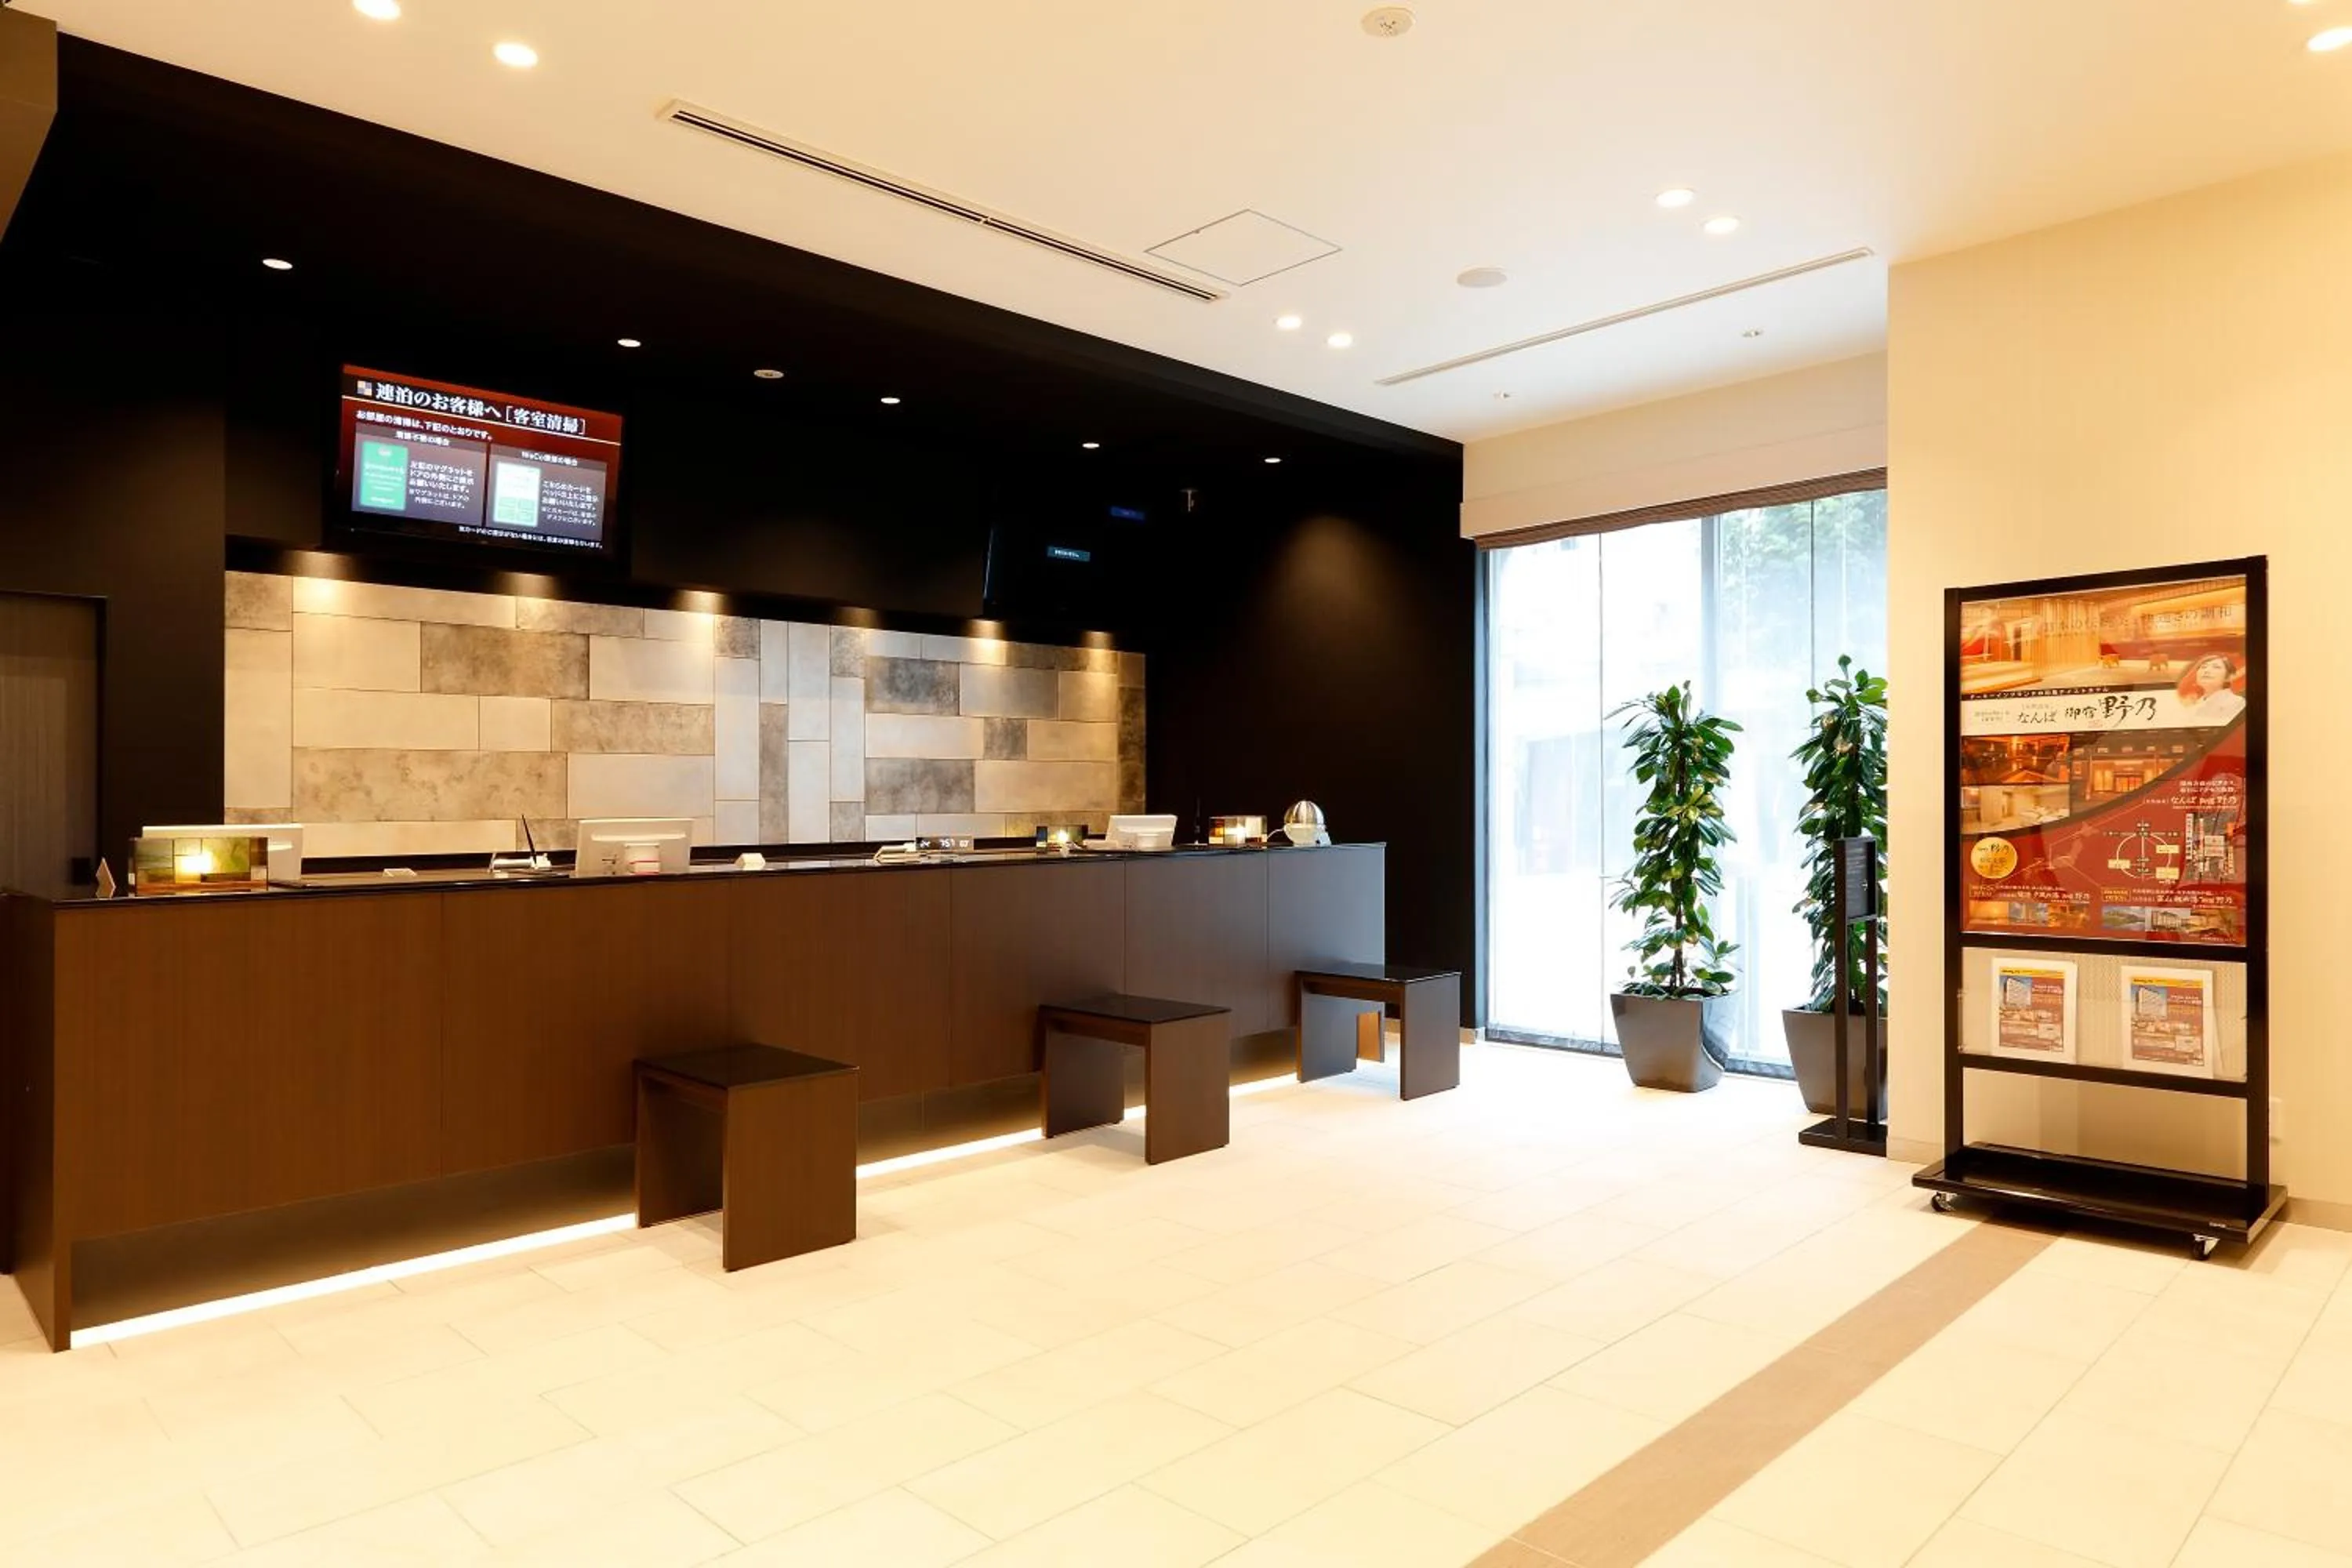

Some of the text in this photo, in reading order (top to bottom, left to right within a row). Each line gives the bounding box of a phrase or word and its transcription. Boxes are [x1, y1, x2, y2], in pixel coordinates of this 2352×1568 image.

[376, 382, 502, 419] 連泊のお客様へ
[2016, 711, 2059, 724] なんば
